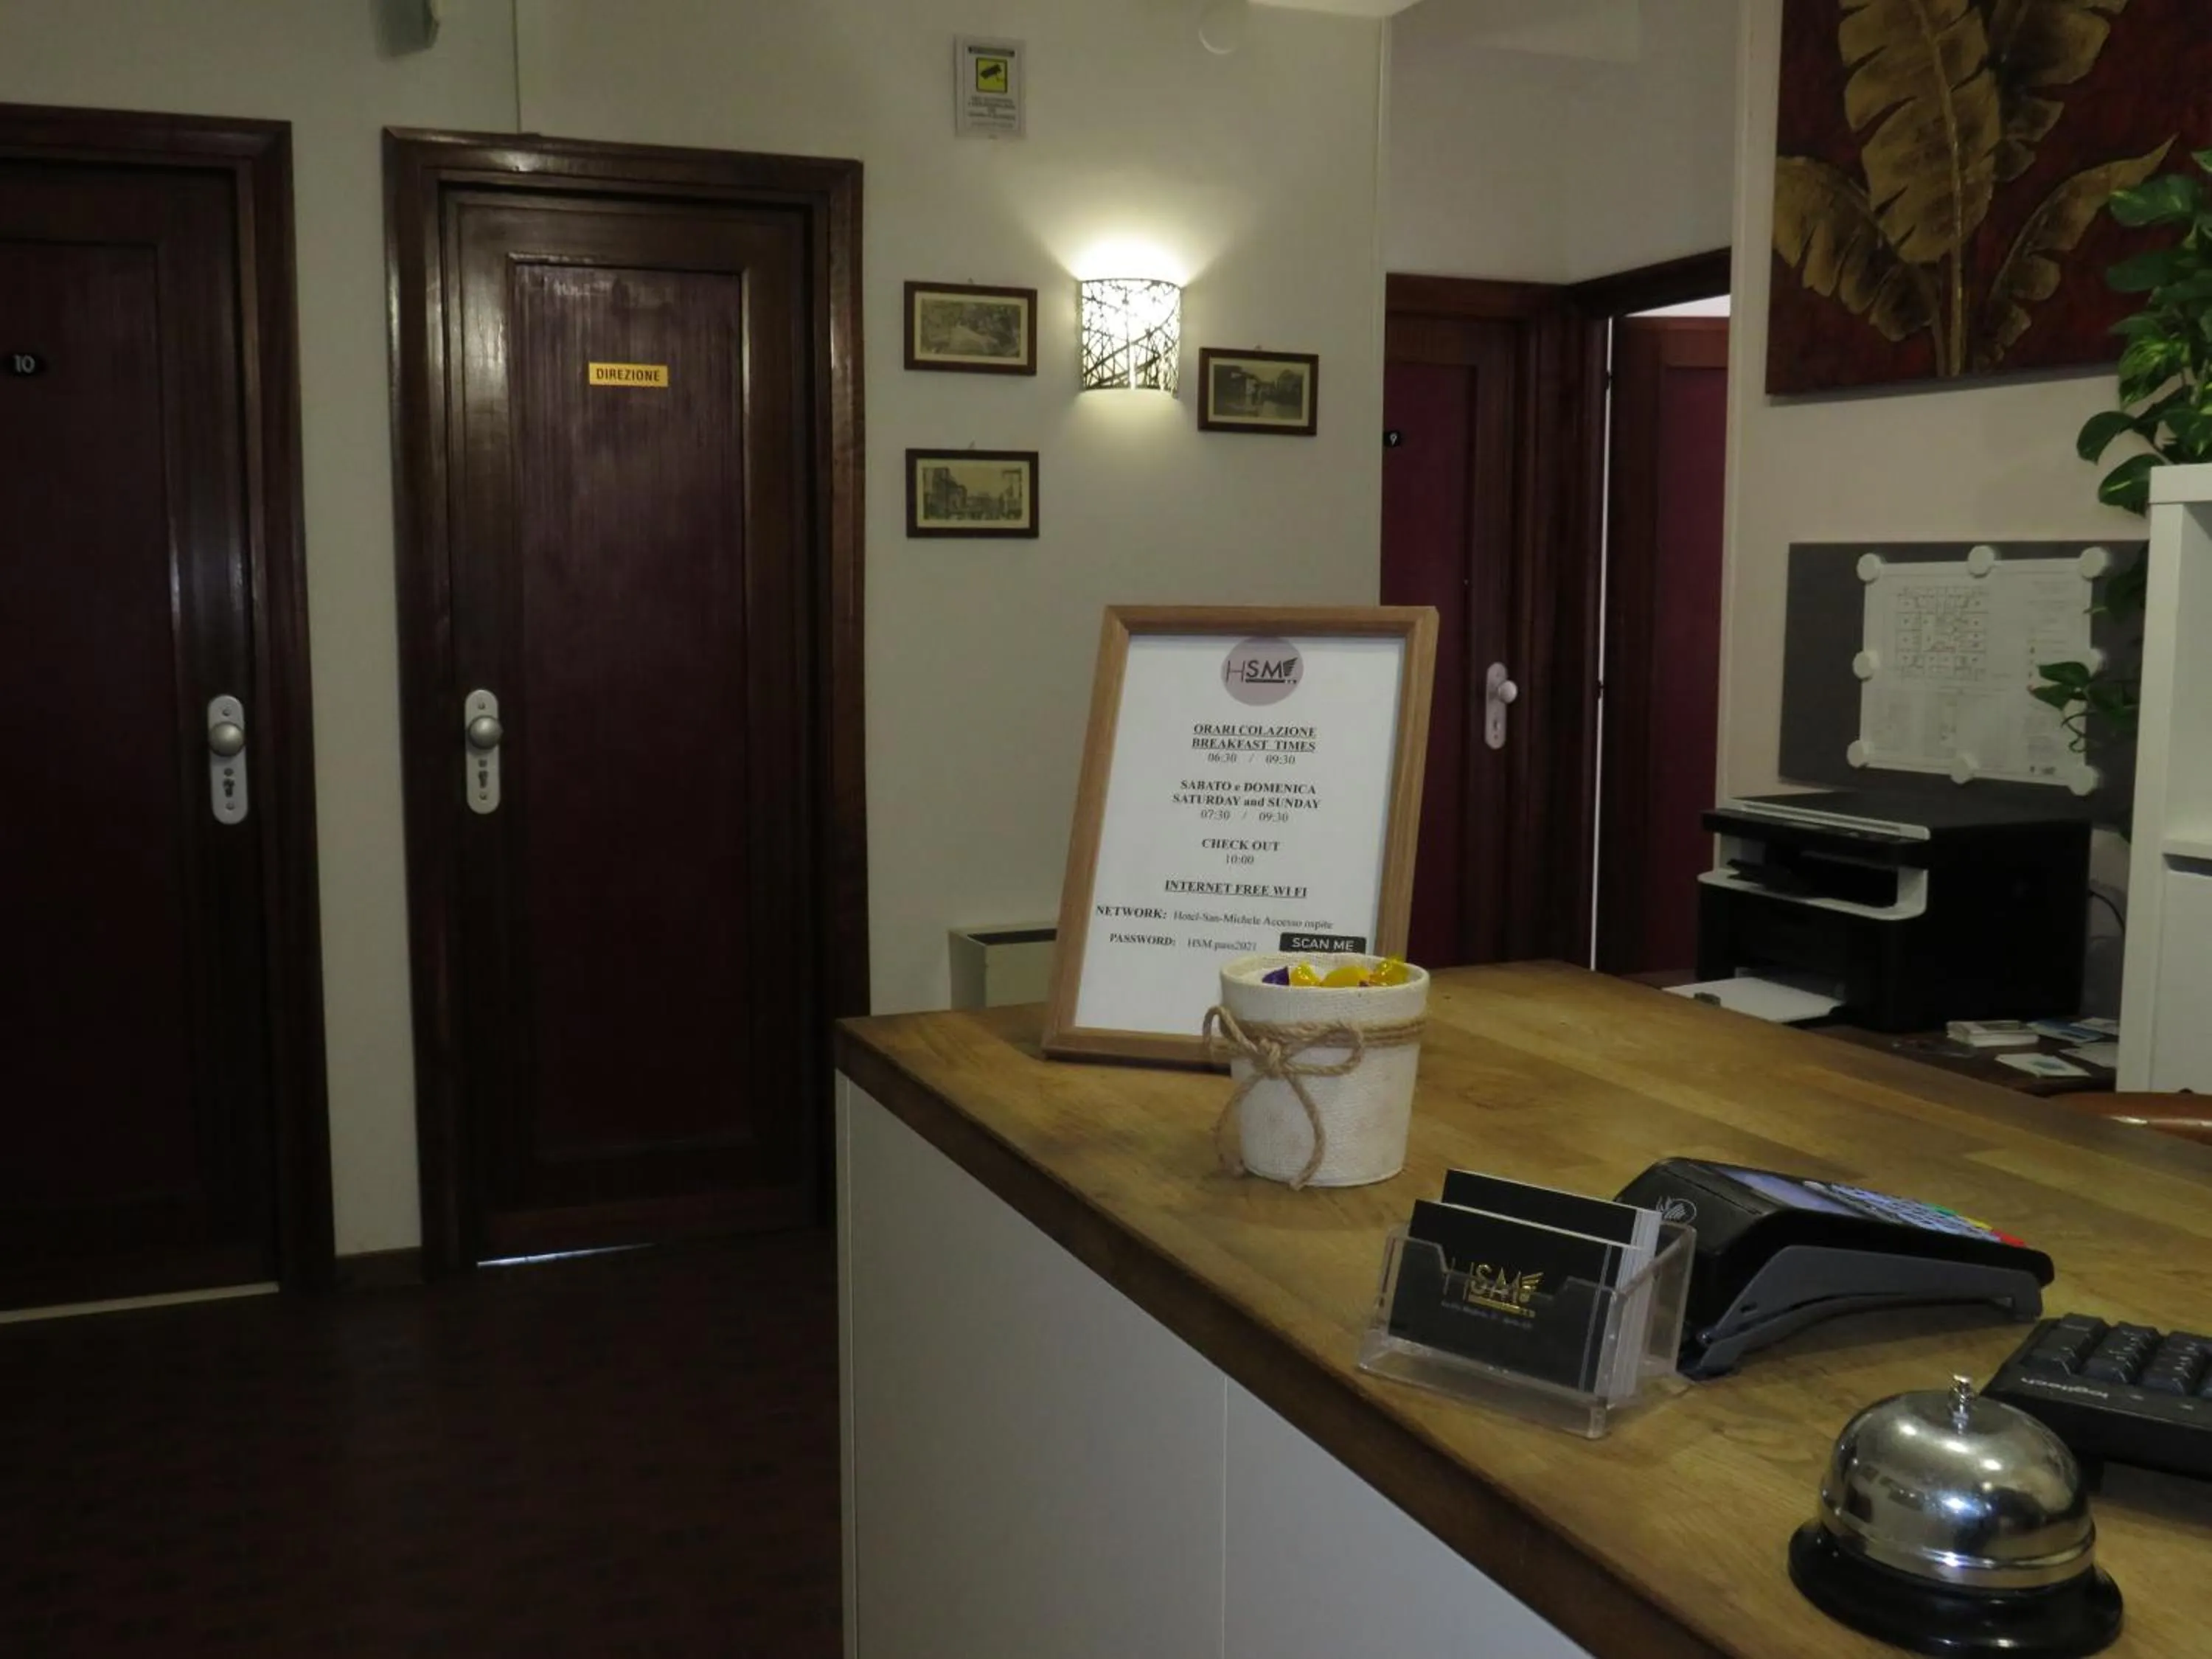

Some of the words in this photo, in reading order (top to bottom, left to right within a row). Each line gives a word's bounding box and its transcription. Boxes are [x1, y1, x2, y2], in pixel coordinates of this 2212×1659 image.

[13, 355, 35, 373] 10
[596, 368, 660, 381] DIREZIONE
[1225, 659, 1283, 683] HSM
[1193, 723, 1236, 736] ORARI
[1238, 725, 1317, 738] COLAZIONE
[1192, 737, 1268, 750] BREAKFAST
[1274, 740, 1316, 752] TIMES
[1207, 752, 1237, 763] 06:30
[1265, 754, 1295, 765] 09:30
[1180, 779, 1232, 791] SABATO
[1243, 782, 1316, 795] DOMENICA
[1172, 793, 1240, 807] SATURDAY
[1243, 796, 1265, 807] and
[1267, 796, 1321, 809] SUNDAY
[1200, 809, 1231, 821] 07:30
[1259, 811, 1289, 823] 09:30
[1201, 838, 1249, 850] CHECK
[1251, 841, 1280, 852] OUT
[1225, 854, 1255, 865] 10:00
[1165, 879, 1233, 894] INTERNET
[1234, 883, 1272, 897] FREE
[1096, 905, 1168, 919] NETWORK:
[1109, 932, 1177, 947] PASSWORD:
[1291, 937, 1329, 950] SCAN
[1332, 939, 1354, 951] ME
